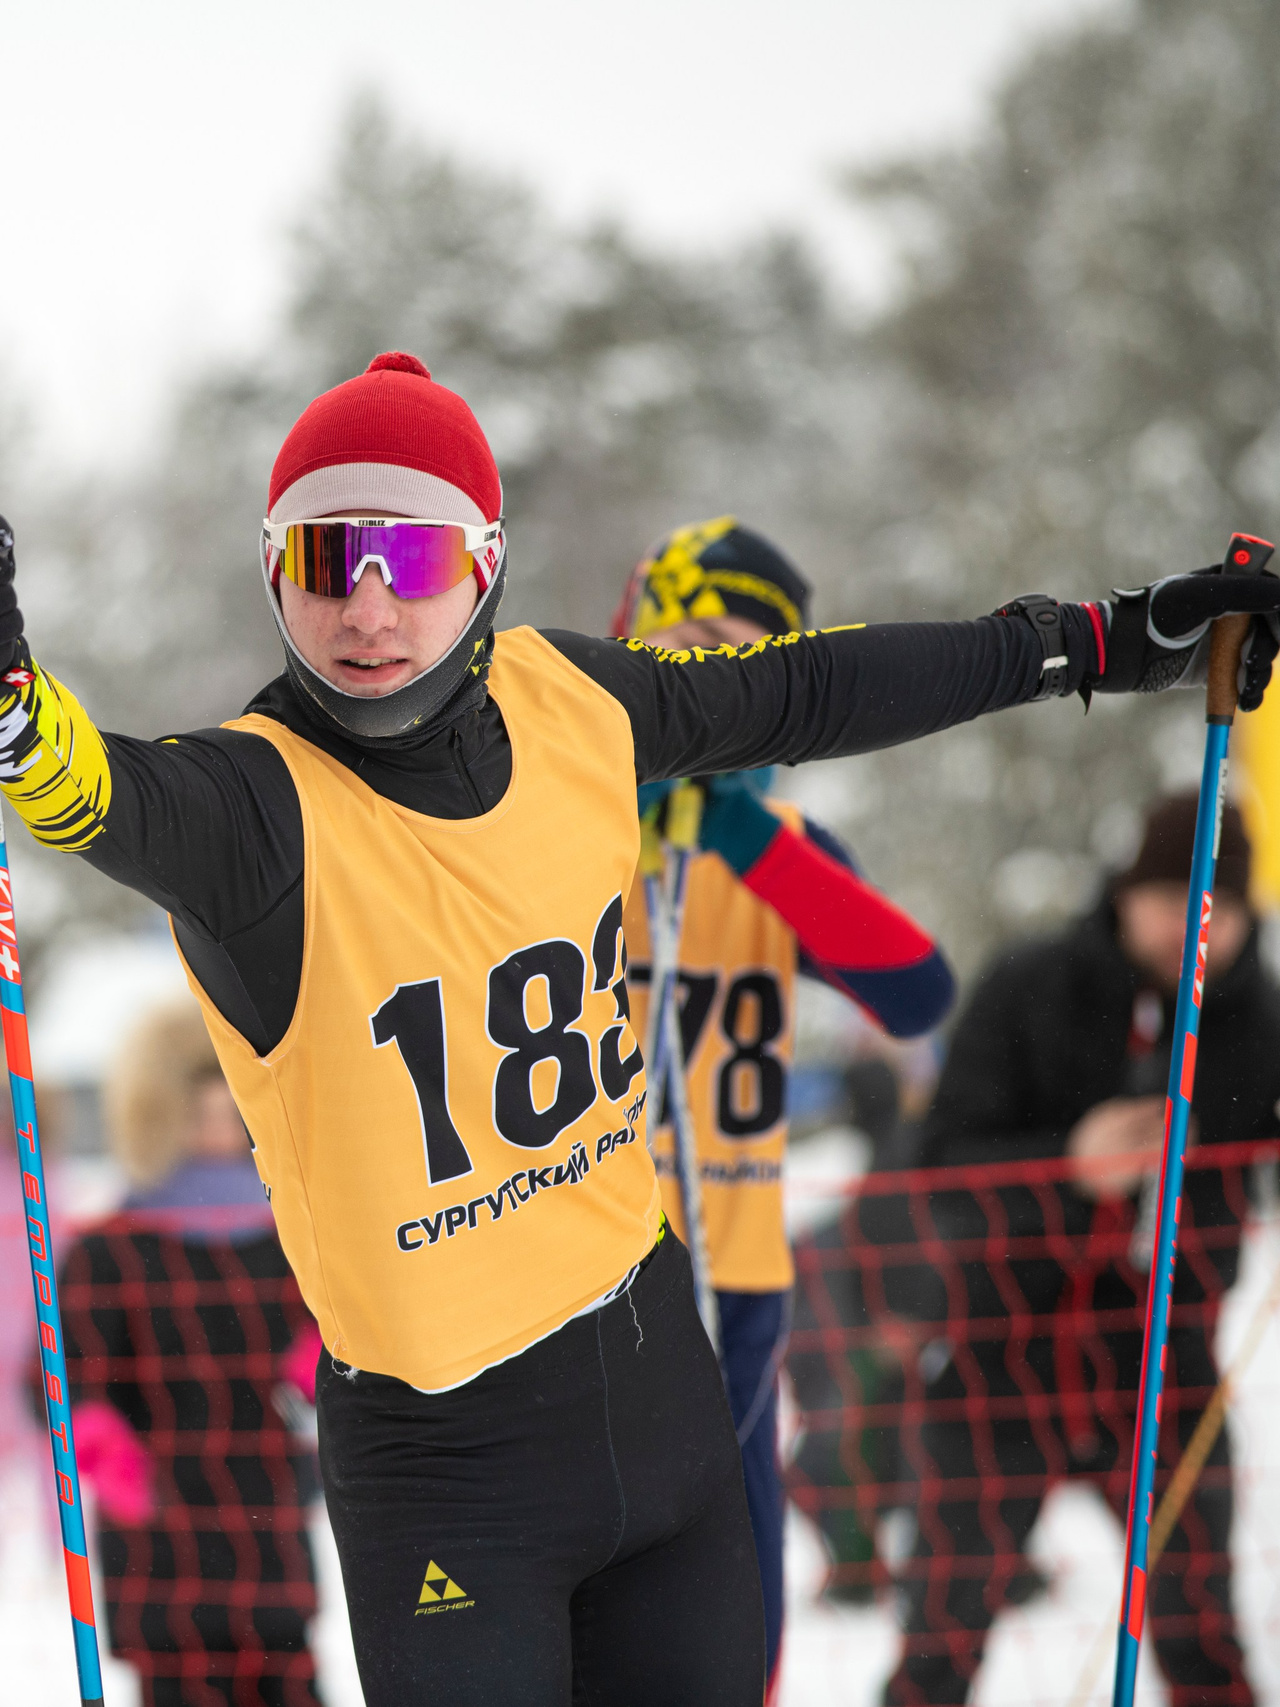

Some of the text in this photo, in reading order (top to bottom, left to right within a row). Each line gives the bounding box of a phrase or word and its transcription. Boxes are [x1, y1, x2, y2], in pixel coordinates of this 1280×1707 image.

[368, 519, 387, 527] BLIZ
[396, 1140, 590, 1252] СУРГУТСКИЙ
[18, 1121, 74, 1506] TEMPESTA
[414, 1599, 476, 1617] FISCHER
